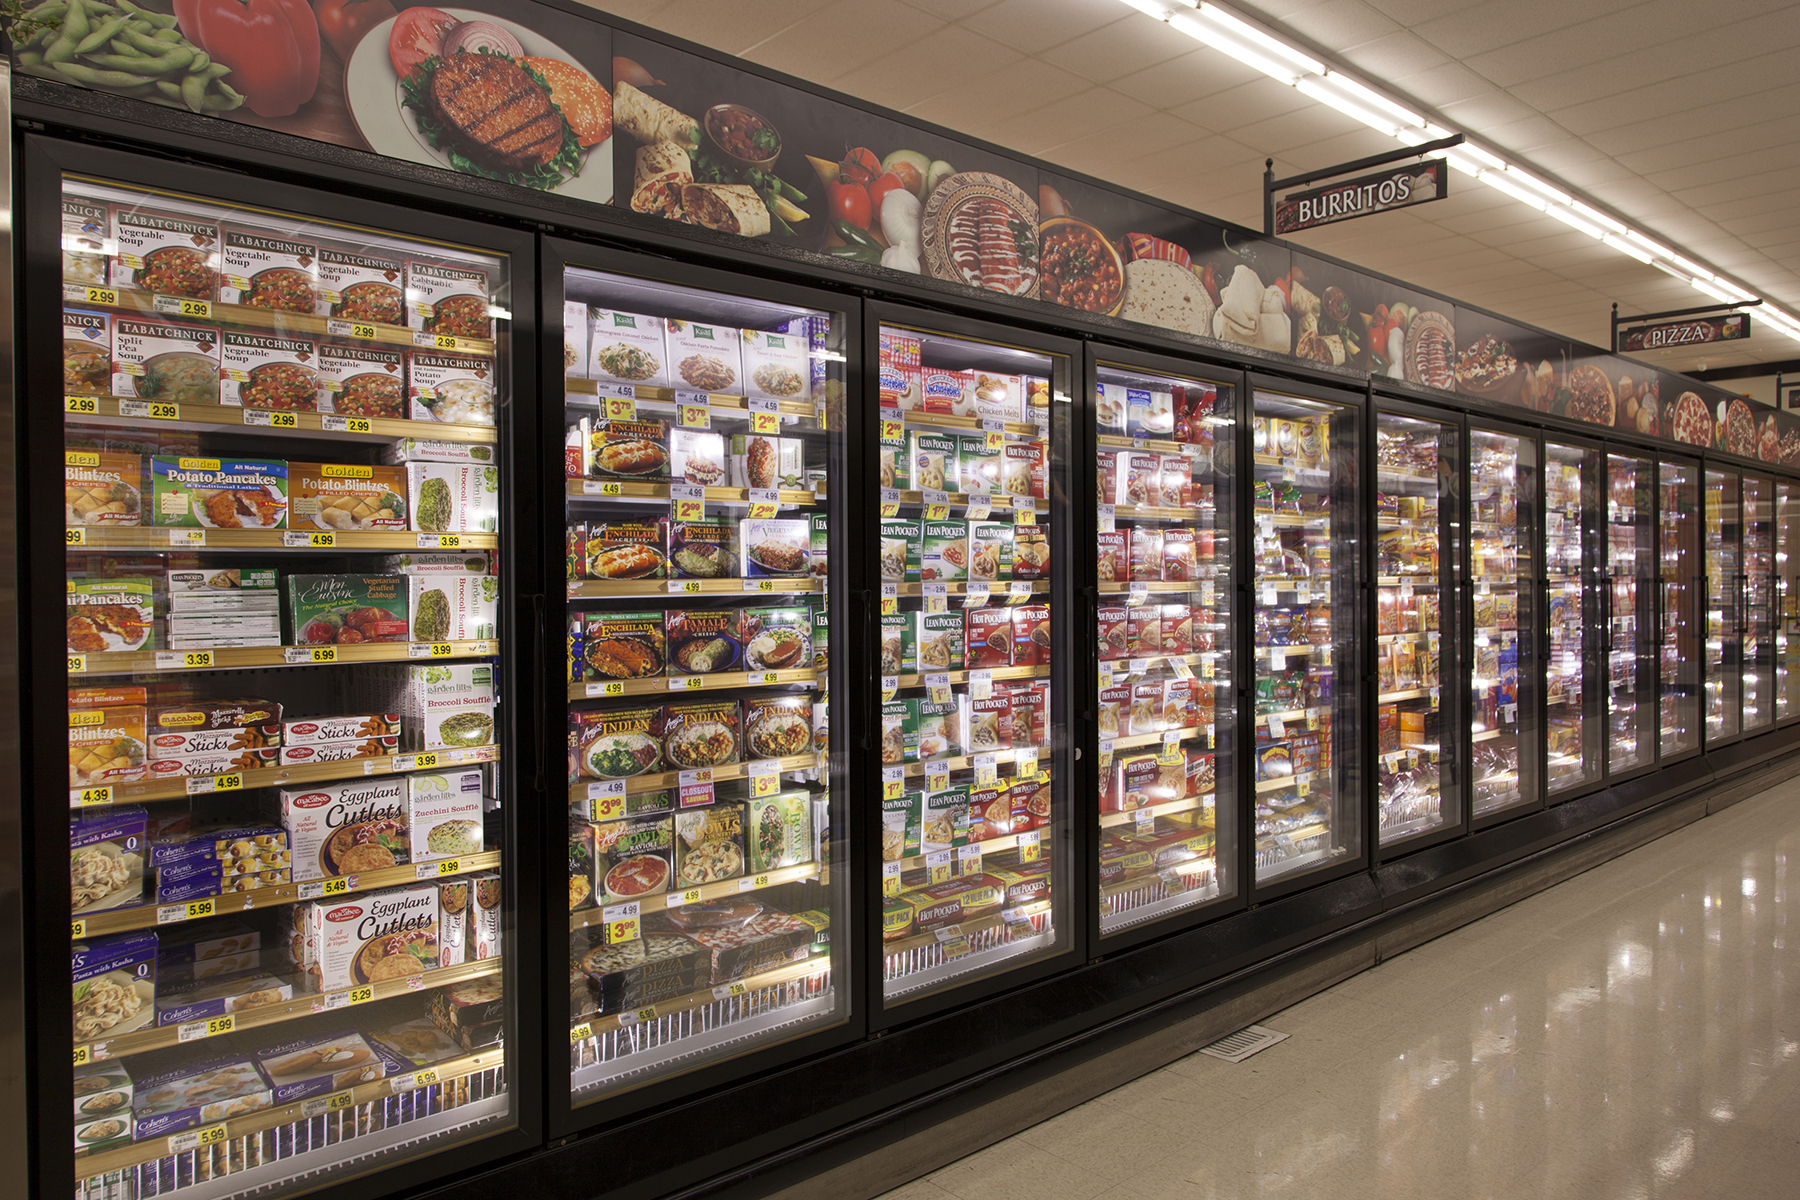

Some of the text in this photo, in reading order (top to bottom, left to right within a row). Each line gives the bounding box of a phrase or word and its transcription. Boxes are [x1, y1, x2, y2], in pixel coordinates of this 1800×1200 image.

[1299, 176, 1411, 222] BURRITOS
[123, 213, 214, 236] TABATCHNICK
[119, 227, 164, 241] Vegetable
[118, 235, 143, 246] Soup
[231, 234, 313, 256] TABATCHNICK
[225, 249, 271, 262] Vegetable
[322, 252, 397, 270] TABATCHNICK
[225, 257, 250, 267] Soup
[318, 263, 360, 276] Vegetable
[318, 271, 341, 282] Soup
[90, 290, 114, 303] 2.99
[184, 303, 207, 315] 2.99
[123, 324, 213, 341] TABATCHNICK
[355, 327, 374, 338] 2.99
[1652, 326, 1704, 345] PIZZA
[118, 336, 142, 345] Split
[228, 335, 310, 351] TABATCHNICK
[438, 337, 455, 348] 2.99
[118, 344, 136, 352] Pea
[224, 346, 269, 358] Vegetable
[118, 352, 144, 361] Soup
[224, 354, 249, 362] Soup
[323, 348, 398, 362] TABATCHNICK
[319, 358, 360, 369] Vegetable
[418, 356, 487, 369] TABATCHNICK
[319, 365, 341, 374] Soup
[415, 371, 441, 379] Potato
[618, 386, 632, 396] 4.59
[694, 394, 707, 404] 4.59
[69, 400, 94, 412] 2.99
[152, 405, 175, 417] 2.99
[978, 406, 1019, 418] Chicken Melts
[273, 415, 295, 426] 2.99
[350, 421, 369, 431] 2.99
[920, 438, 954, 450] LEAN POCKETS
[1007, 447, 1040, 459] HOT POCKETS
[181, 459, 219, 469] Golden
[66, 468, 120, 482] Blintzes
[167, 470, 277, 485] Potato Pancakes
[324, 467, 370, 477] Golden
[302, 478, 389, 492] Potato Blintzes
[603, 484, 618, 493] 4.49
[688, 488, 702, 497] 4.99
[604, 530, 659, 542] ENCHILADA
[684, 527, 733, 539] ENCHILADA
[927, 526, 965, 536] LEAN POCKETS
[313, 535, 333, 545] 4.99
[441, 537, 459, 546] 3.99
[685, 582, 700, 591] 4.99
[759, 582, 773, 590] 4.99
[80, 593, 143, 605] Pancakes
[683, 618, 728, 630] TAMALE
[926, 617, 962, 627] LEAN POCKETS
[601, 624, 656, 637] ENCHILADA
[315, 650, 334, 660] 6.99
[433, 645, 451, 655] 3.99
[187, 654, 210, 665] 3.39
[606, 684, 621, 693] 4.99
[687, 678, 701, 687] 4.99
[427, 683, 472, 695] garden lites
[428, 697, 491, 707] Broccoli Soufflé
[974, 698, 1008, 709] HOT POCKETS
[162, 714, 203, 723] macabee
[684, 712, 728, 726] INDIAN
[603, 719, 650, 734] INDIAN
[71, 727, 125, 740] Blintzes
[318, 726, 355, 740] Sticks
[185, 738, 228, 752] Sticks
[418, 756, 435, 766] 3.99
[1128, 760, 1156, 773] HOT POCKETS
[218, 776, 239, 788] 4.99
[608, 783, 623, 792] 4.99
[84, 790, 108, 802] 4.39
[339, 786, 401, 806] Eggplant
[681, 785, 712, 797] CLOSEOUT
[686, 794, 709, 803] SAVINGS
[930, 793, 966, 807] LEAN POCKETS
[326, 802, 402, 828] Cutlets
[415, 804, 478, 817] Zucchini Soufflé
[695, 819, 741, 840] BOWLS
[617, 828, 668, 851] BOWLS
[156, 846, 185, 858] Cohen's
[630, 841, 657, 851] RAVIOLI
[164, 864, 192, 876] Cohen's
[441, 862, 458, 872] 3.99
[162, 884, 190, 896] Cohen's
[326, 881, 346, 892] 5.49
[685, 891, 699, 900] 4.99
[962, 888, 994, 905] 12 VALUE PACK
[189, 903, 212, 916] 5.99
[371, 896, 431, 917] Eggplant
[920, 903, 960, 921] HOT POCKETS
[357, 913, 432, 940] Cutlets
[73, 972, 93, 981] Pasta
[112, 957, 133, 968] Kasha
[730, 983, 744, 994] 7.99
[352, 990, 371, 1001] 5.29
[163, 1006, 192, 1021] Cohen's
[210, 1019, 231, 1032] 5.99
[417, 1073, 436, 1085] 6.99
[278, 1083, 305, 1097] Cohen's
[331, 1095, 351, 1108] 4.99
[138, 1115, 168, 1132] Cohen's
[202, 1129, 224, 1143] 5.99
